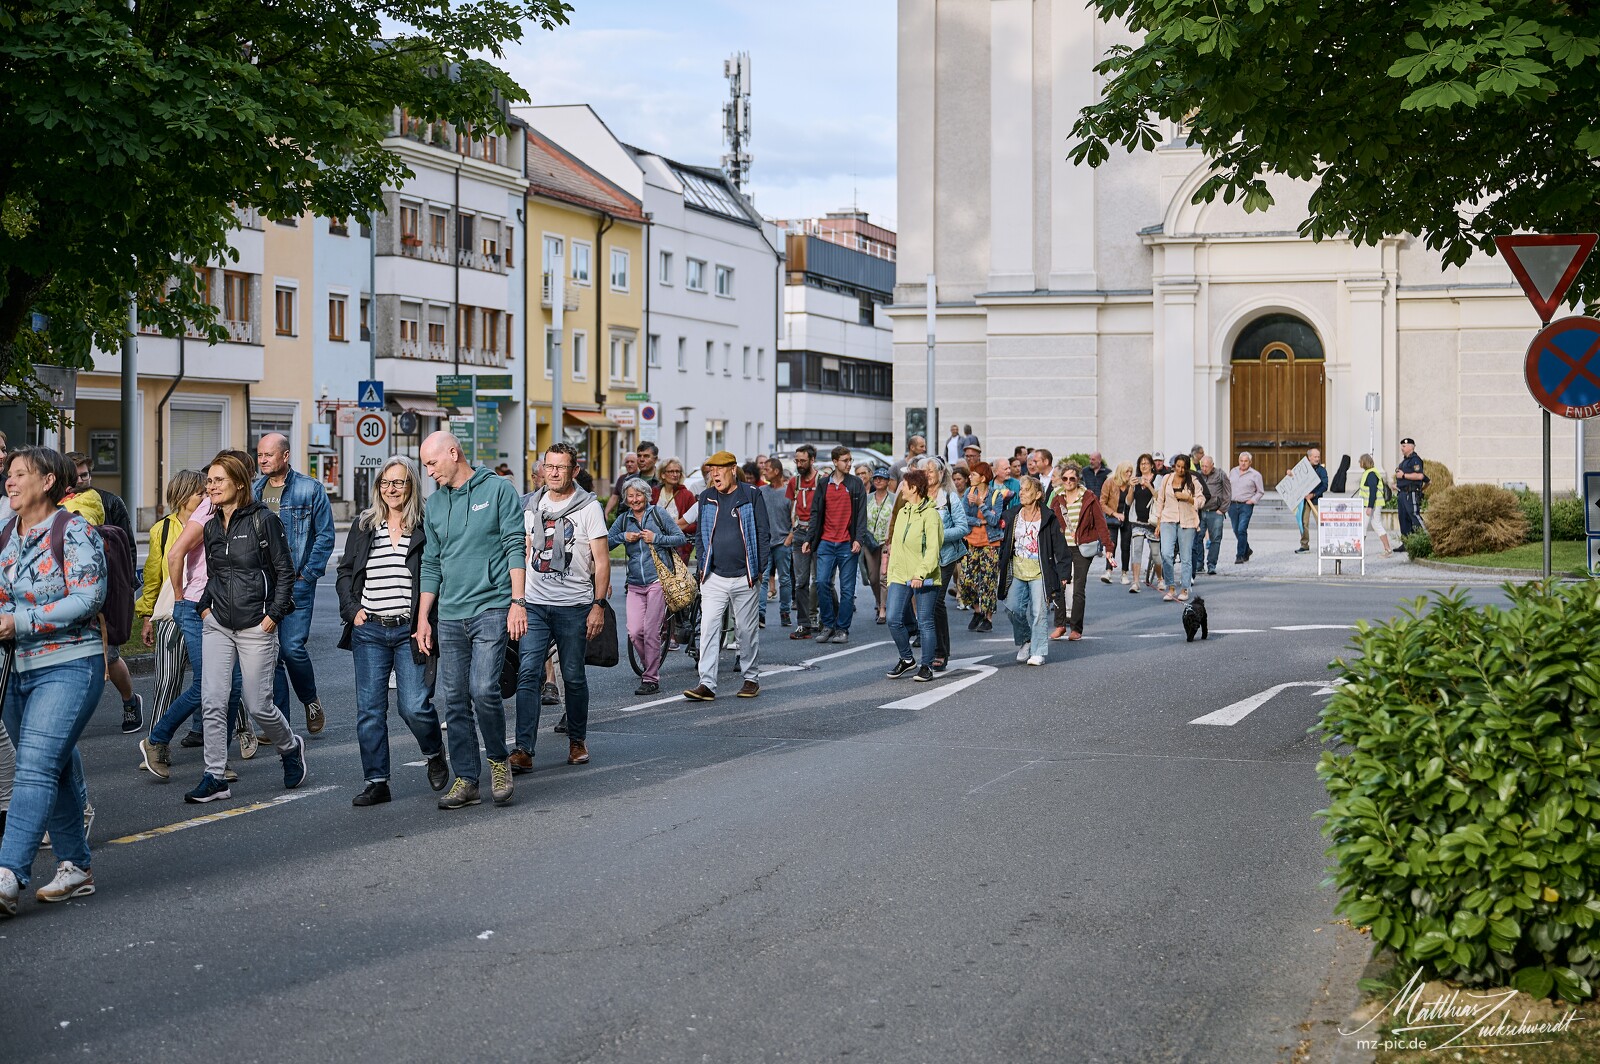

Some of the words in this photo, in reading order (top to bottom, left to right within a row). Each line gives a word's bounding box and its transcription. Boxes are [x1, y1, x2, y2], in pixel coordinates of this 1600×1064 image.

[1565, 402, 1600, 418] ENDE
[363, 421, 380, 438] 30
[360, 455, 382, 466] Zone
